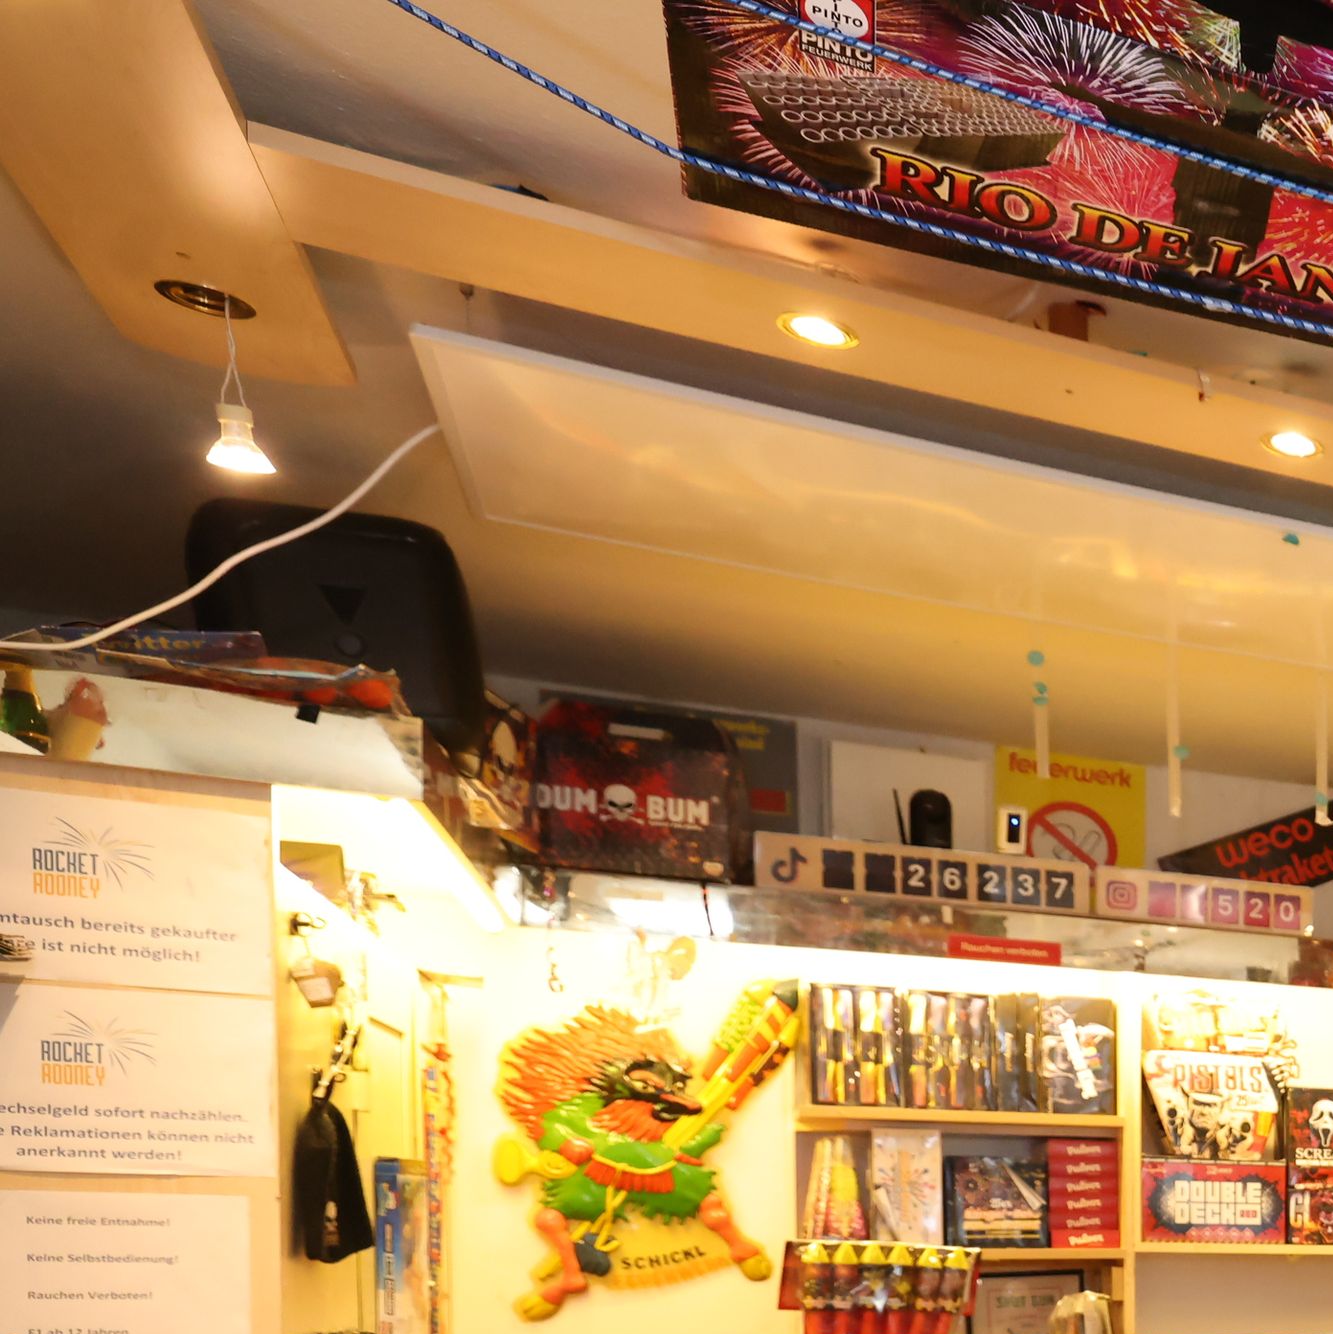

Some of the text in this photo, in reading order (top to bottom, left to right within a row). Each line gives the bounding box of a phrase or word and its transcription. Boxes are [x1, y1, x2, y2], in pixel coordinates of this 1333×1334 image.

[870, 146, 1057, 231] RIO
[1070, 203, 1196, 267] DE
[536, 784, 710, 826] DUM BUM
[1216, 818, 1316, 869] weco
[32, 848, 99, 875] ROCKET
[81, 915, 238, 944] bereits gekaufter
[69, 942, 201, 965] nicht möglich!
[41, 1040, 104, 1064] ROCKET
[95, 1106, 145, 1120] sofort
[10, 1125, 256, 1146] Reklamationen können nicht
[15, 1147, 183, 1163] anerkannt werden!
[1173, 1180, 1263, 1202] DOUBLE
[26, 1216, 63, 1226] Keine
